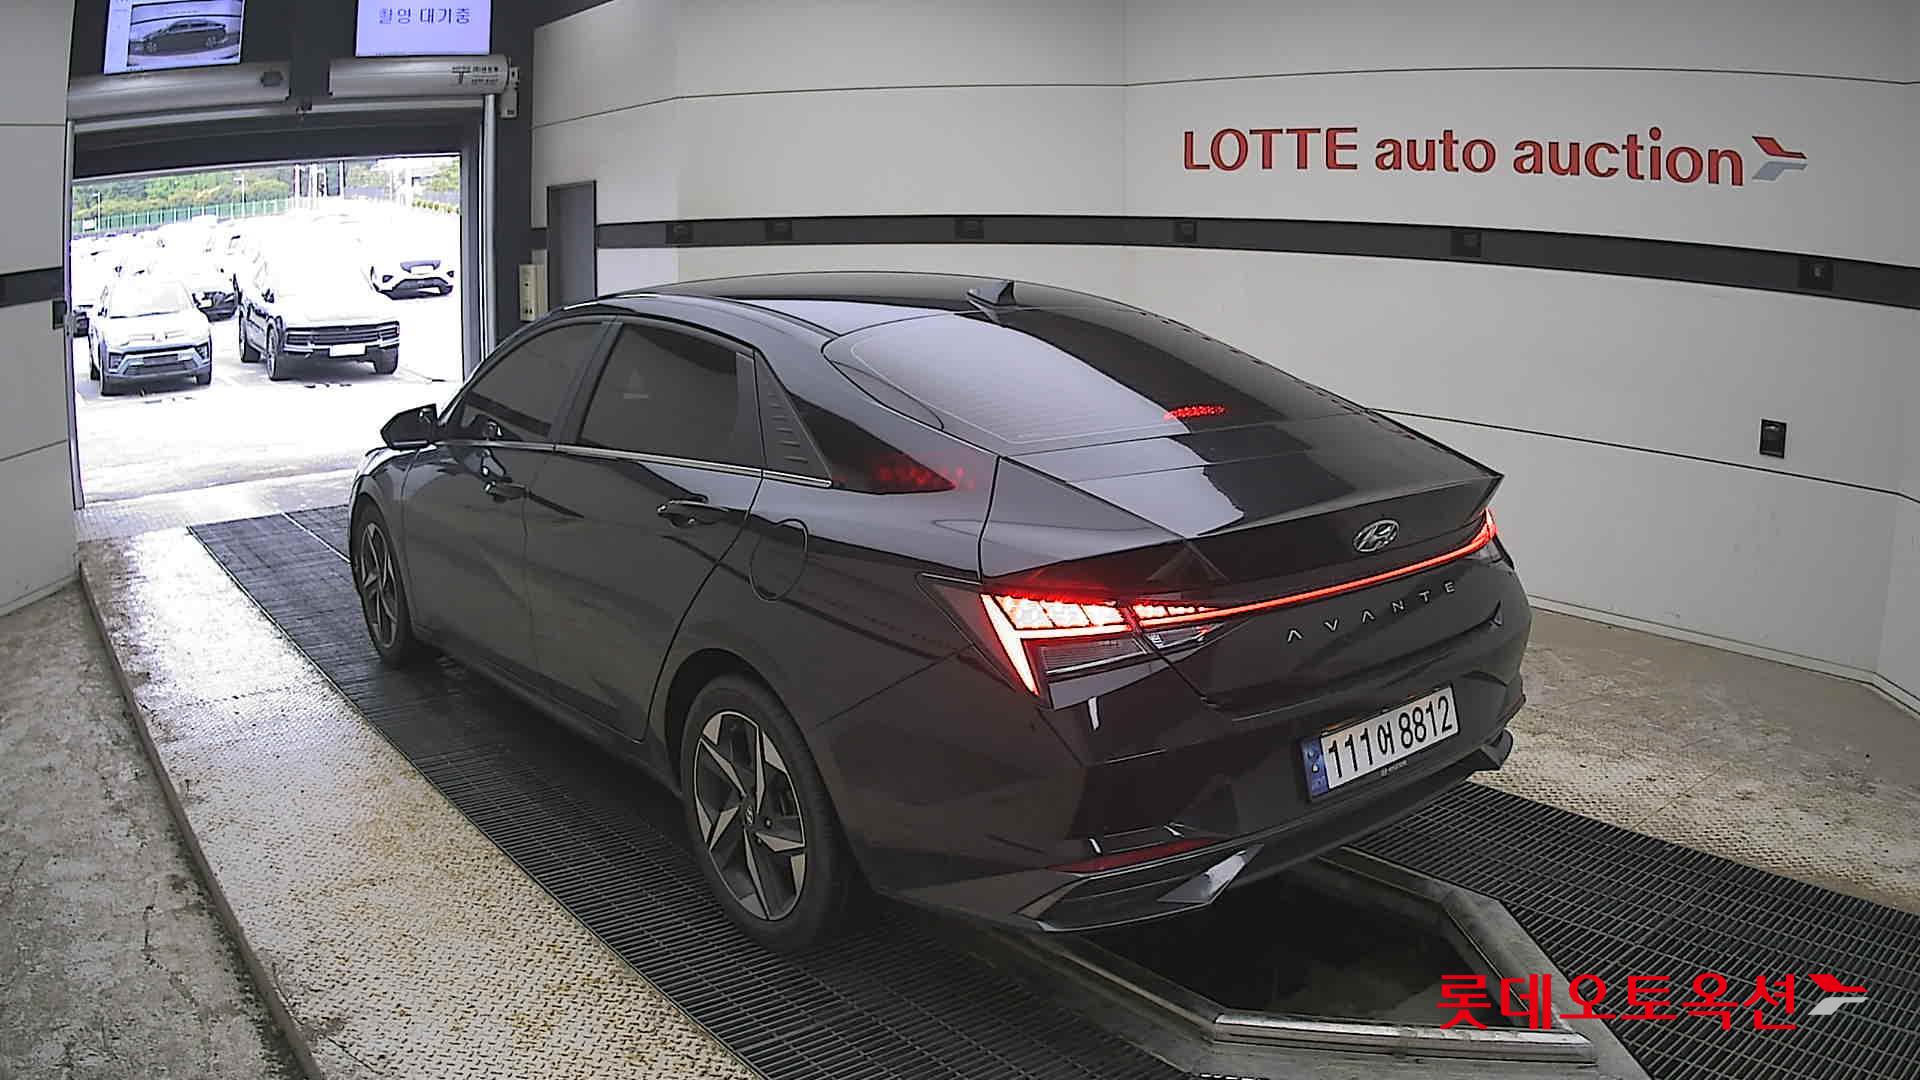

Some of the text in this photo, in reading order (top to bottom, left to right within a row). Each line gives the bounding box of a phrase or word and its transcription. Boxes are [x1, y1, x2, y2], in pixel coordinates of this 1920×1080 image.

[419, 7, 471, 25] 대기중
[1183, 126, 1745, 187] LOTTE auto auction
[1286, 582, 1456, 643] AVANTE
[1398, 695, 1453, 749] 8812
